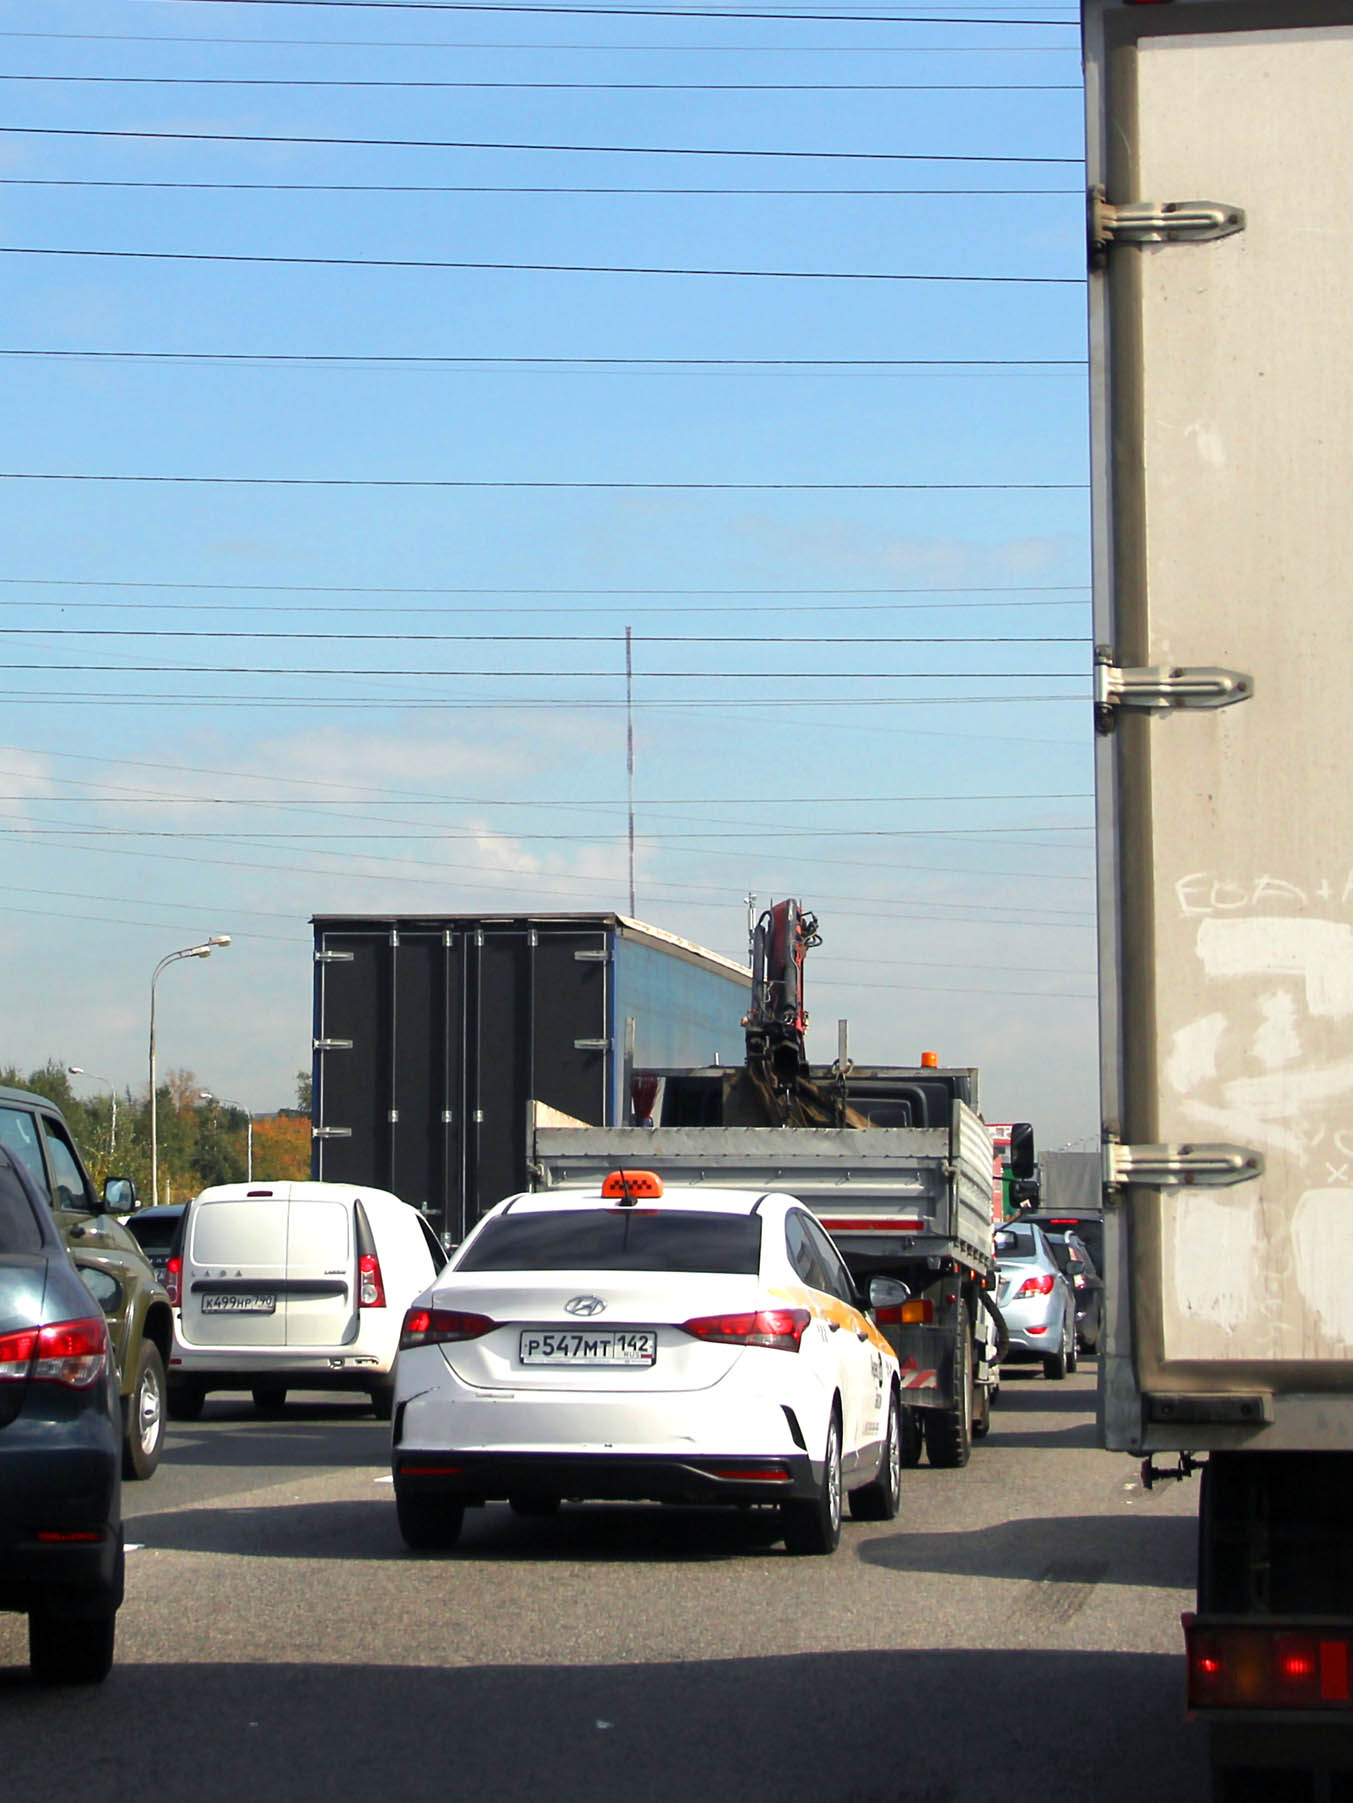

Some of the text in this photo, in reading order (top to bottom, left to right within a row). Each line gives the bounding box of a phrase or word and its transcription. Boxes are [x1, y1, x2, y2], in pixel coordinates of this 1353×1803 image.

[191, 1269, 243, 1278] LADA
[528, 1335, 648, 1357] Р547МТ 142
